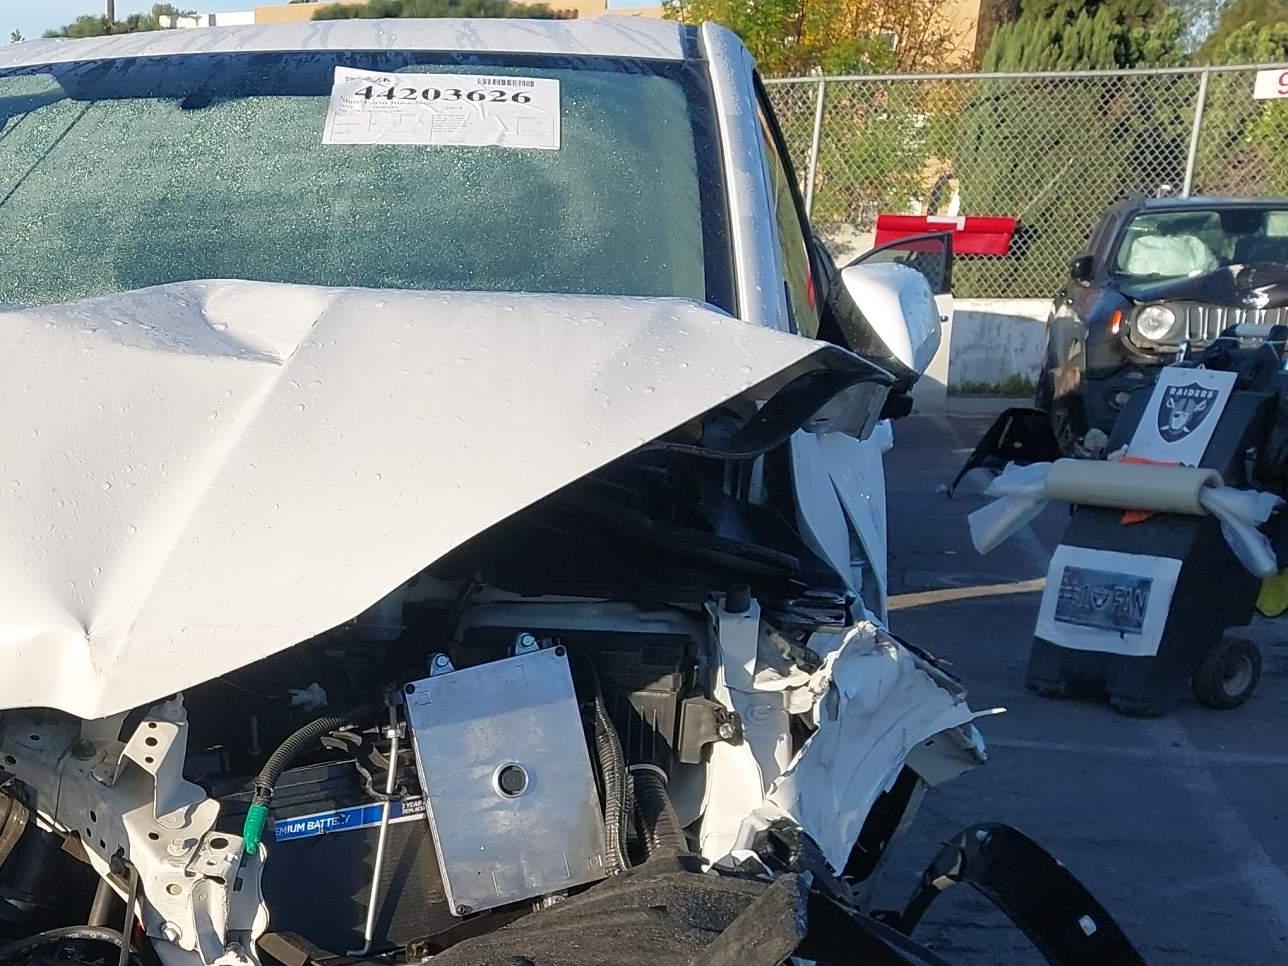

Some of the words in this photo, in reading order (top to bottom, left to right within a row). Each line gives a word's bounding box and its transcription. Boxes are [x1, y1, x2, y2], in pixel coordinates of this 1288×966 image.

[355, 85, 531, 104] 44203626
[1170, 387, 1215, 398] RAIDERS
[1113, 585, 1148, 620] FAN
